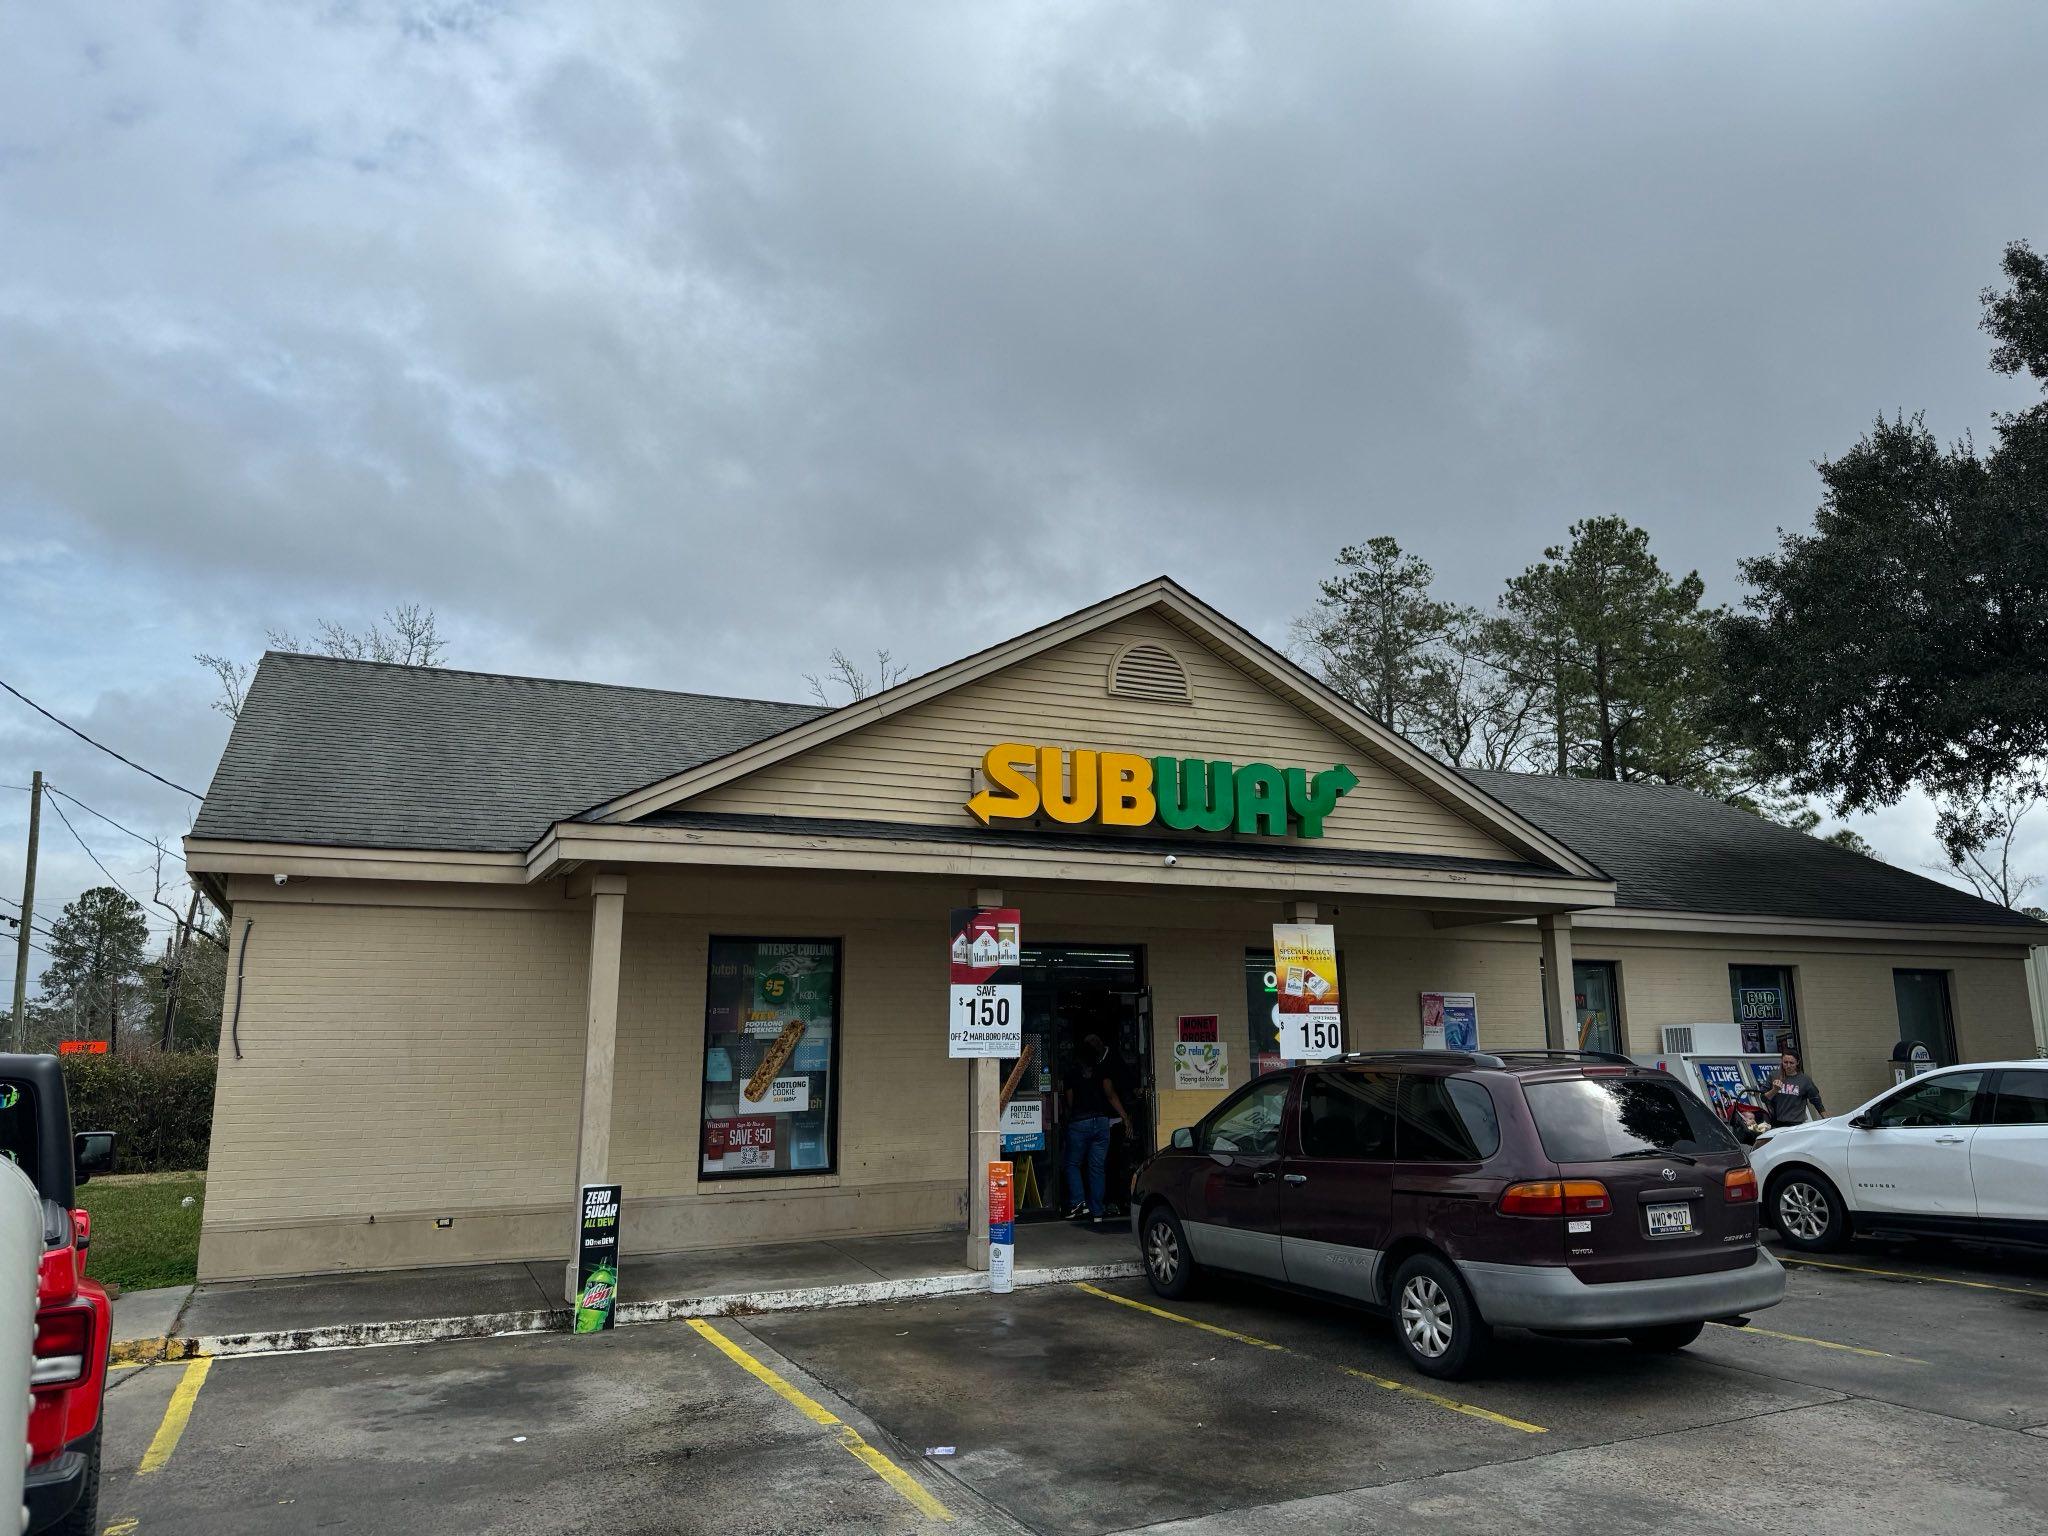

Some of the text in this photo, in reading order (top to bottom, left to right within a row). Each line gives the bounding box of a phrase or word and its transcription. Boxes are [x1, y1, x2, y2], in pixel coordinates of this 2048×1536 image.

[964, 743, 1360, 838] SUBWAY
[766, 979, 785, 997] $5
[977, 986, 997, 997] SAVE
[800, 991, 819, 1000] KOOL
[1747, 991, 1775, 1005] BUD
[1744, 1004, 1781, 1018] LIGHT
[745, 1020, 784, 1028] FOOTLONG
[1184, 1018, 1215, 1029] MONEY
[951, 1030, 1020, 1041] OFF 2 MARLBORO PACKS
[1182, 1032, 1217, 1042] ORDERS
[1915, 1051, 1928, 1059] AIR
[1717, 1071, 1741, 1082] LIKE
[773, 1080, 807, 1089] FOOTLONG
[1010, 1104, 1040, 1112] FOOTLONG
[707, 1120, 730, 1129] Winston
[730, 1128, 772, 1146] SAVE $50
[585, 1190, 612, 1205] ZERO
[585, 1204, 619, 1219] SUGAR
[584, 1217, 616, 1228] ALL DEW
[1673, 1211, 1688, 1225] 907
[602, 1237, 615, 1245] DEW
